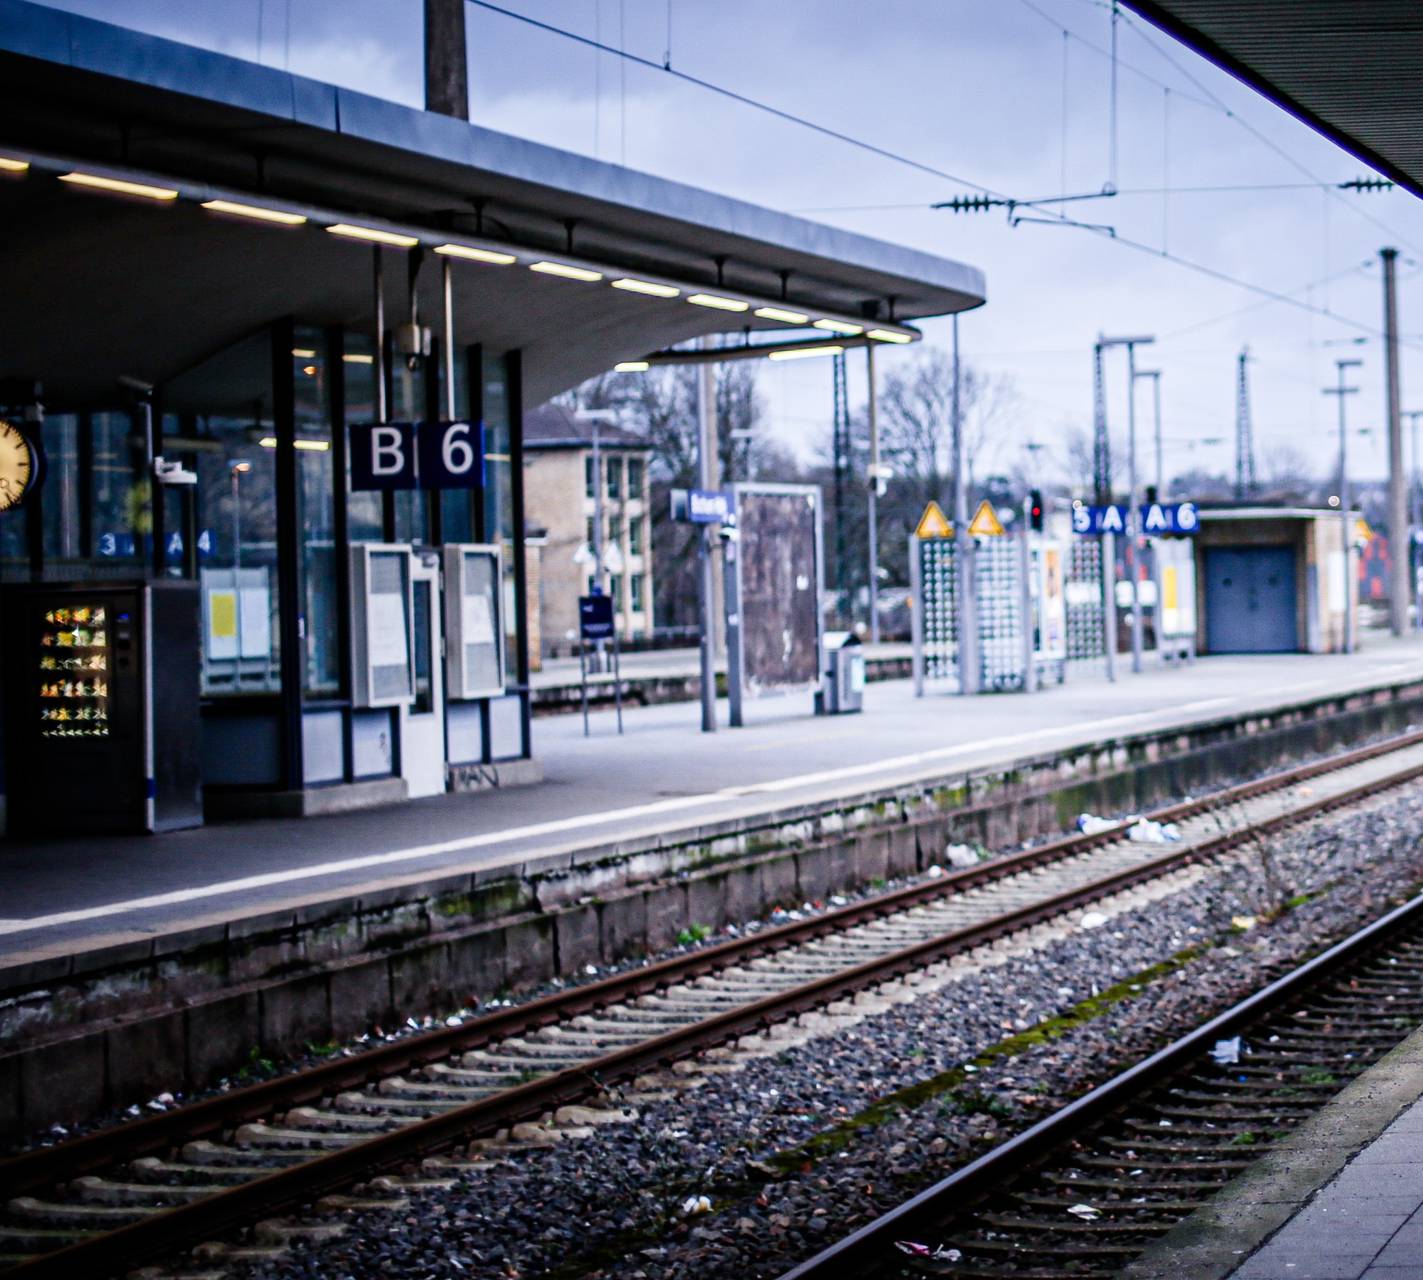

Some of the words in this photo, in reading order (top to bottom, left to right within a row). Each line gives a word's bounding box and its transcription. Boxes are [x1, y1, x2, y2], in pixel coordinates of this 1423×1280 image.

[371, 426, 405, 476] B
[442, 423, 473, 474] 6
[1073, 505, 1091, 532] 5
[1102, 505, 1123, 531] A
[1145, 503, 1167, 531] A
[1177, 502, 1197, 530] 6
[101, 532, 116, 556] 3
